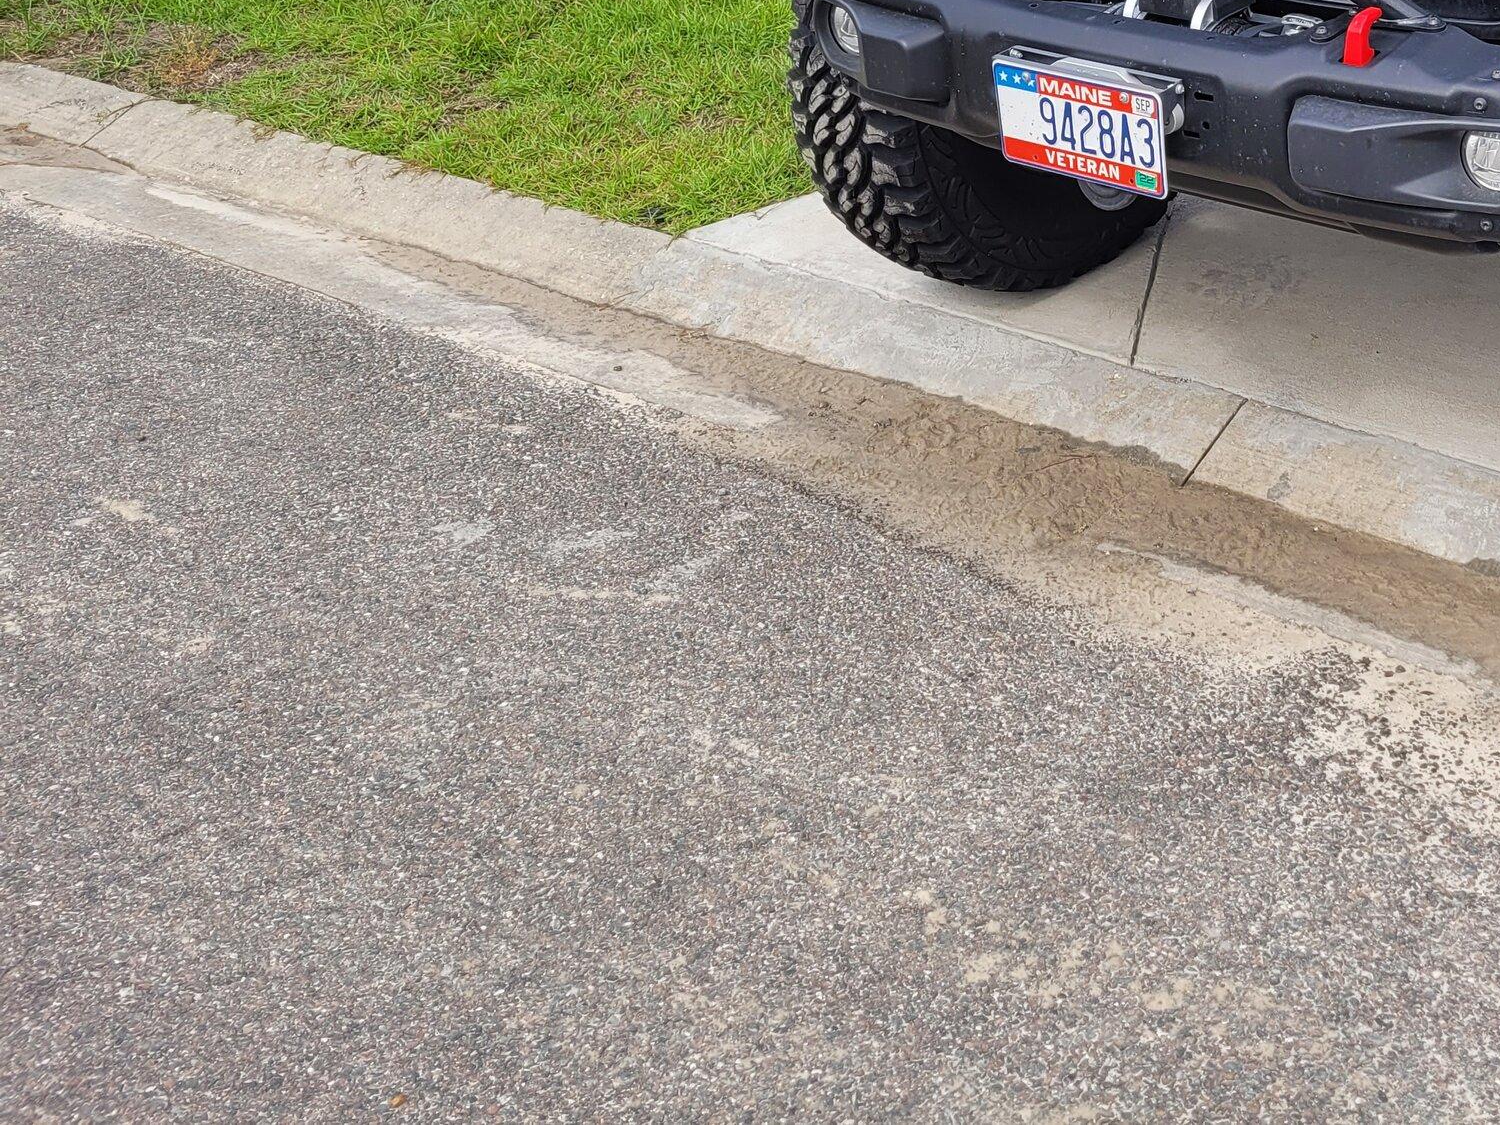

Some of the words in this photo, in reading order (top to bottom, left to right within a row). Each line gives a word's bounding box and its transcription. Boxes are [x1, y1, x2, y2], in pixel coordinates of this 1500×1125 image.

[1039, 77, 1112, 107] MAINE
[1135, 97, 1151, 112] SEP
[1039, 97, 1155, 168] 9428A3
[1045, 149, 1120, 181] VETERAN
